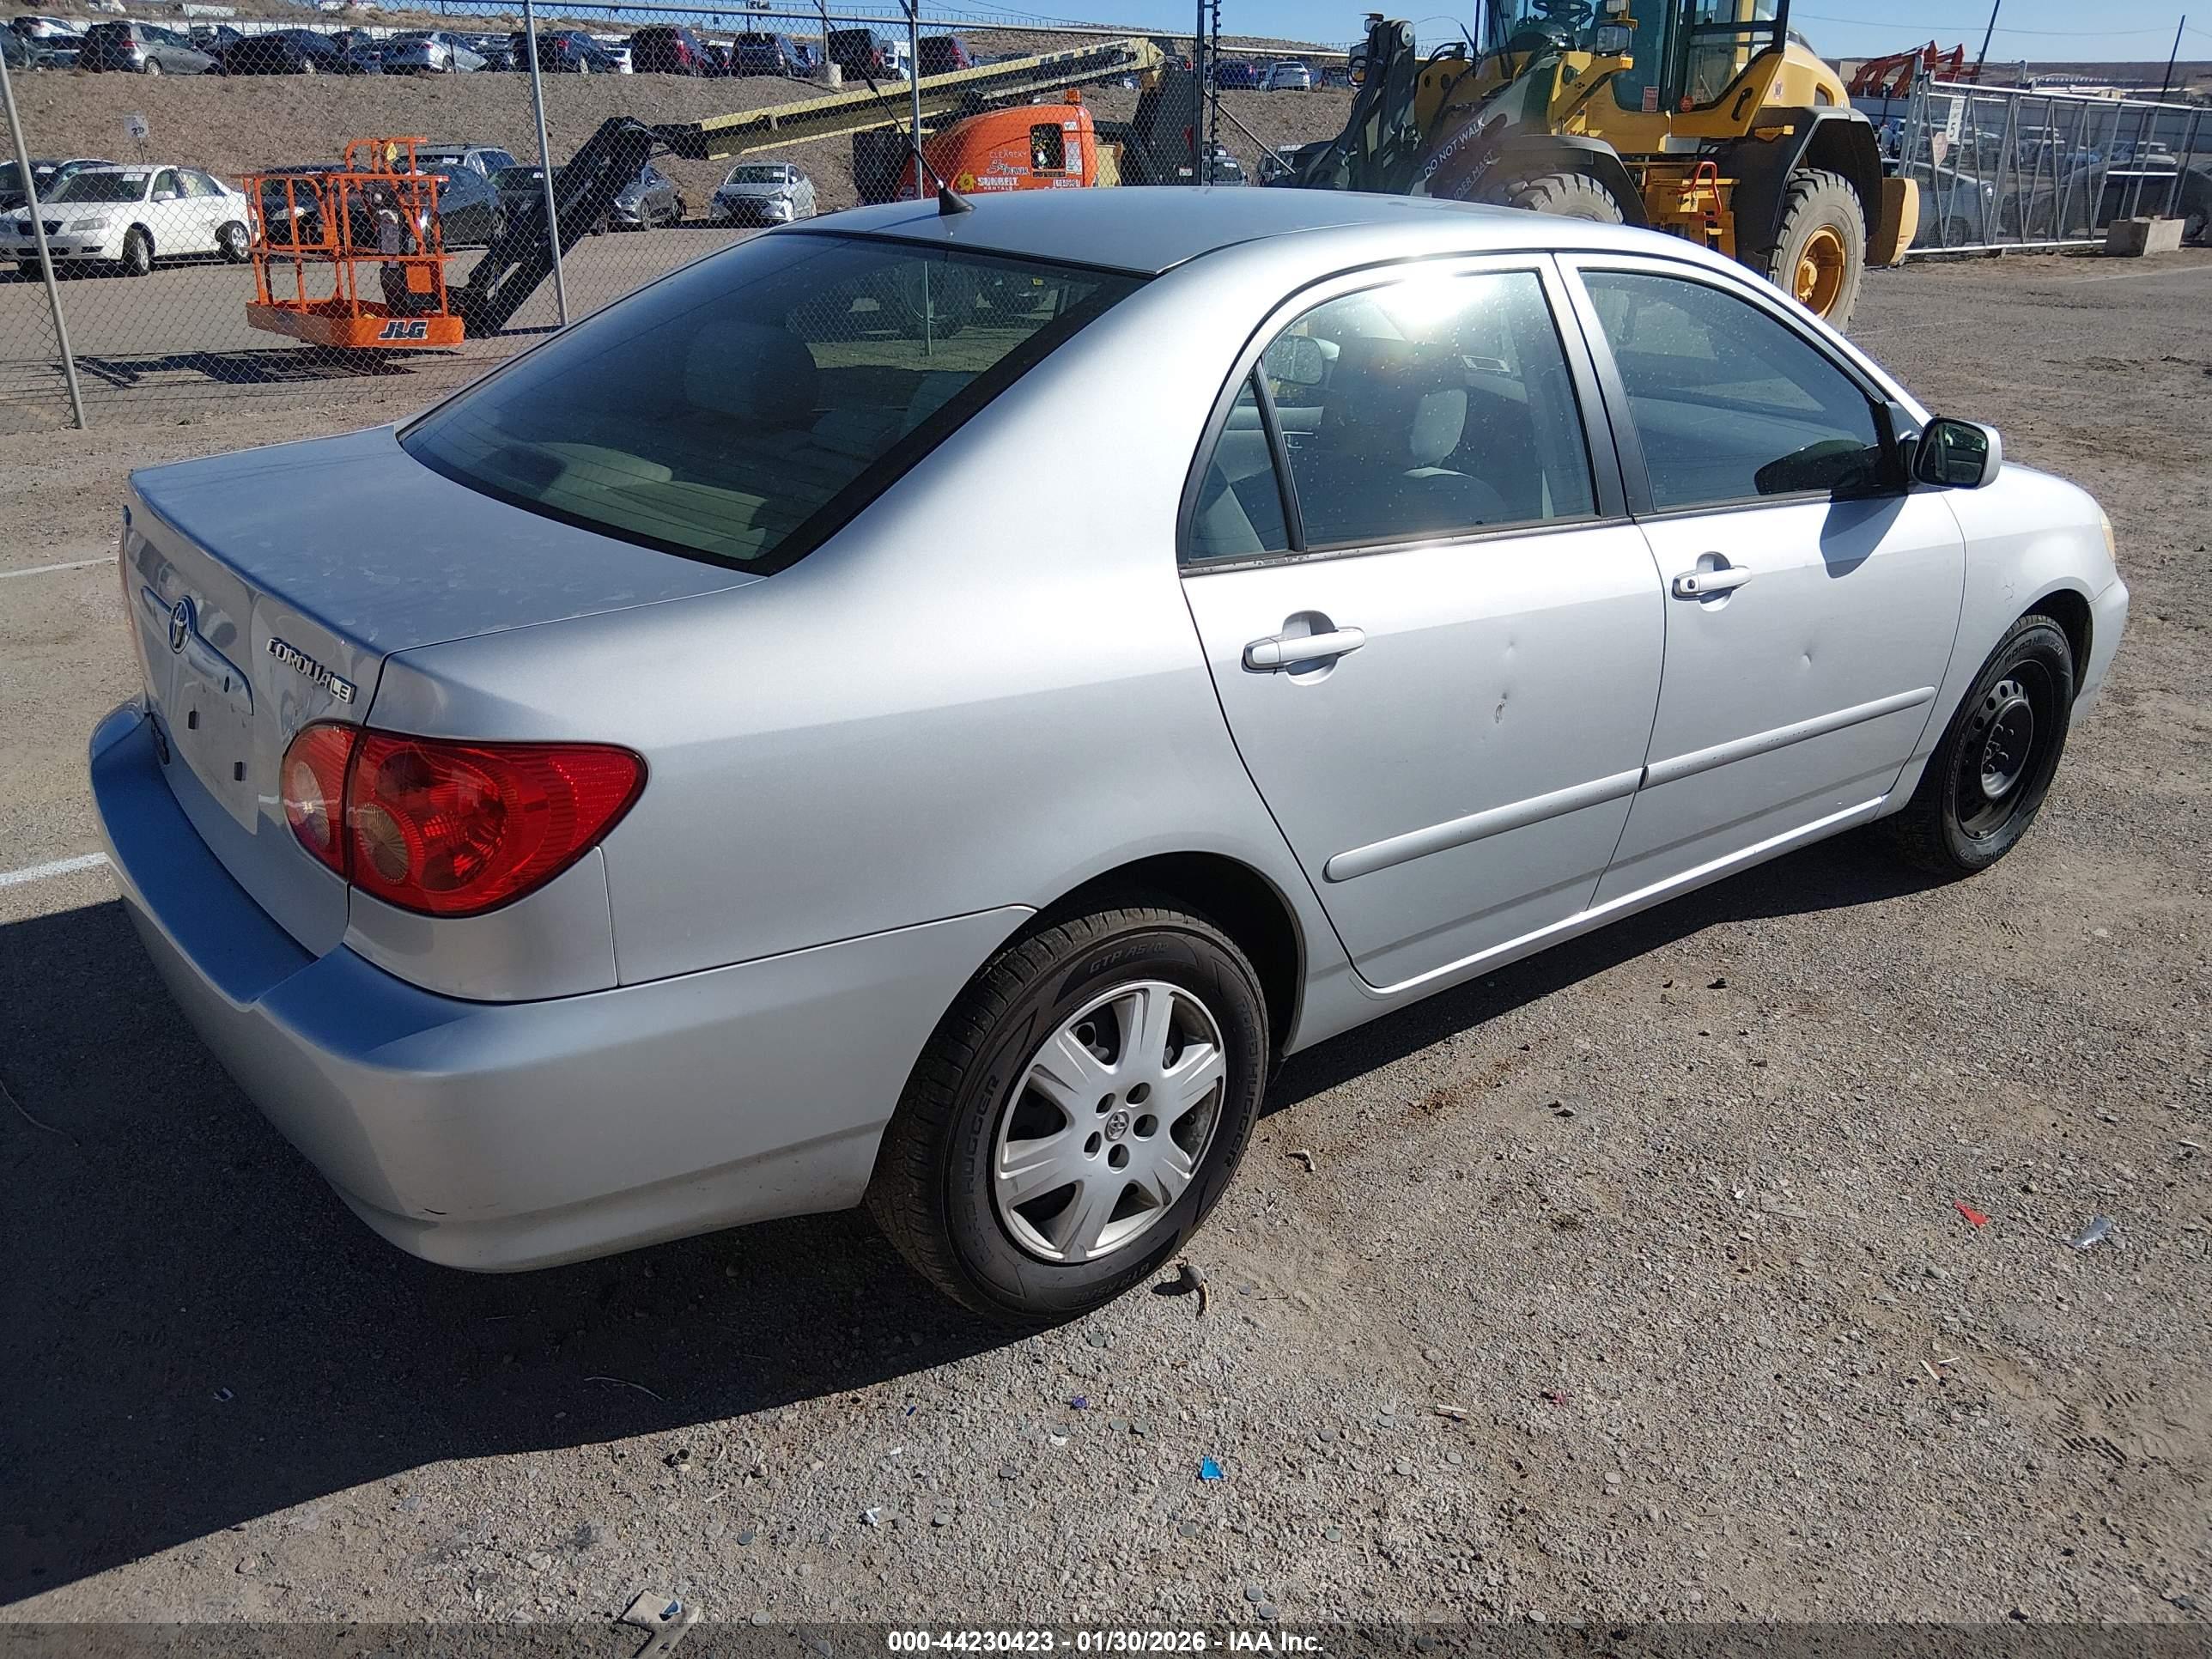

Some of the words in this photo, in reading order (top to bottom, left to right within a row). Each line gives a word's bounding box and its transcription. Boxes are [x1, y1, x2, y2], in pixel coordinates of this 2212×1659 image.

[1424, 159, 1438, 179] DO
[1438, 139, 1458, 163] NOT
[1459, 117, 1486, 144] WALK
[1949, 122, 1956, 138] 5
[977, 177, 1020, 186] SUNBELT
[378, 319, 428, 340] JLG
[266, 637, 331, 690] COROLLA
[330, 677, 354, 703] LE
[961, 1073, 1000, 1196] HUGGER
[1223, 1063, 1258, 1168] HUGGER
